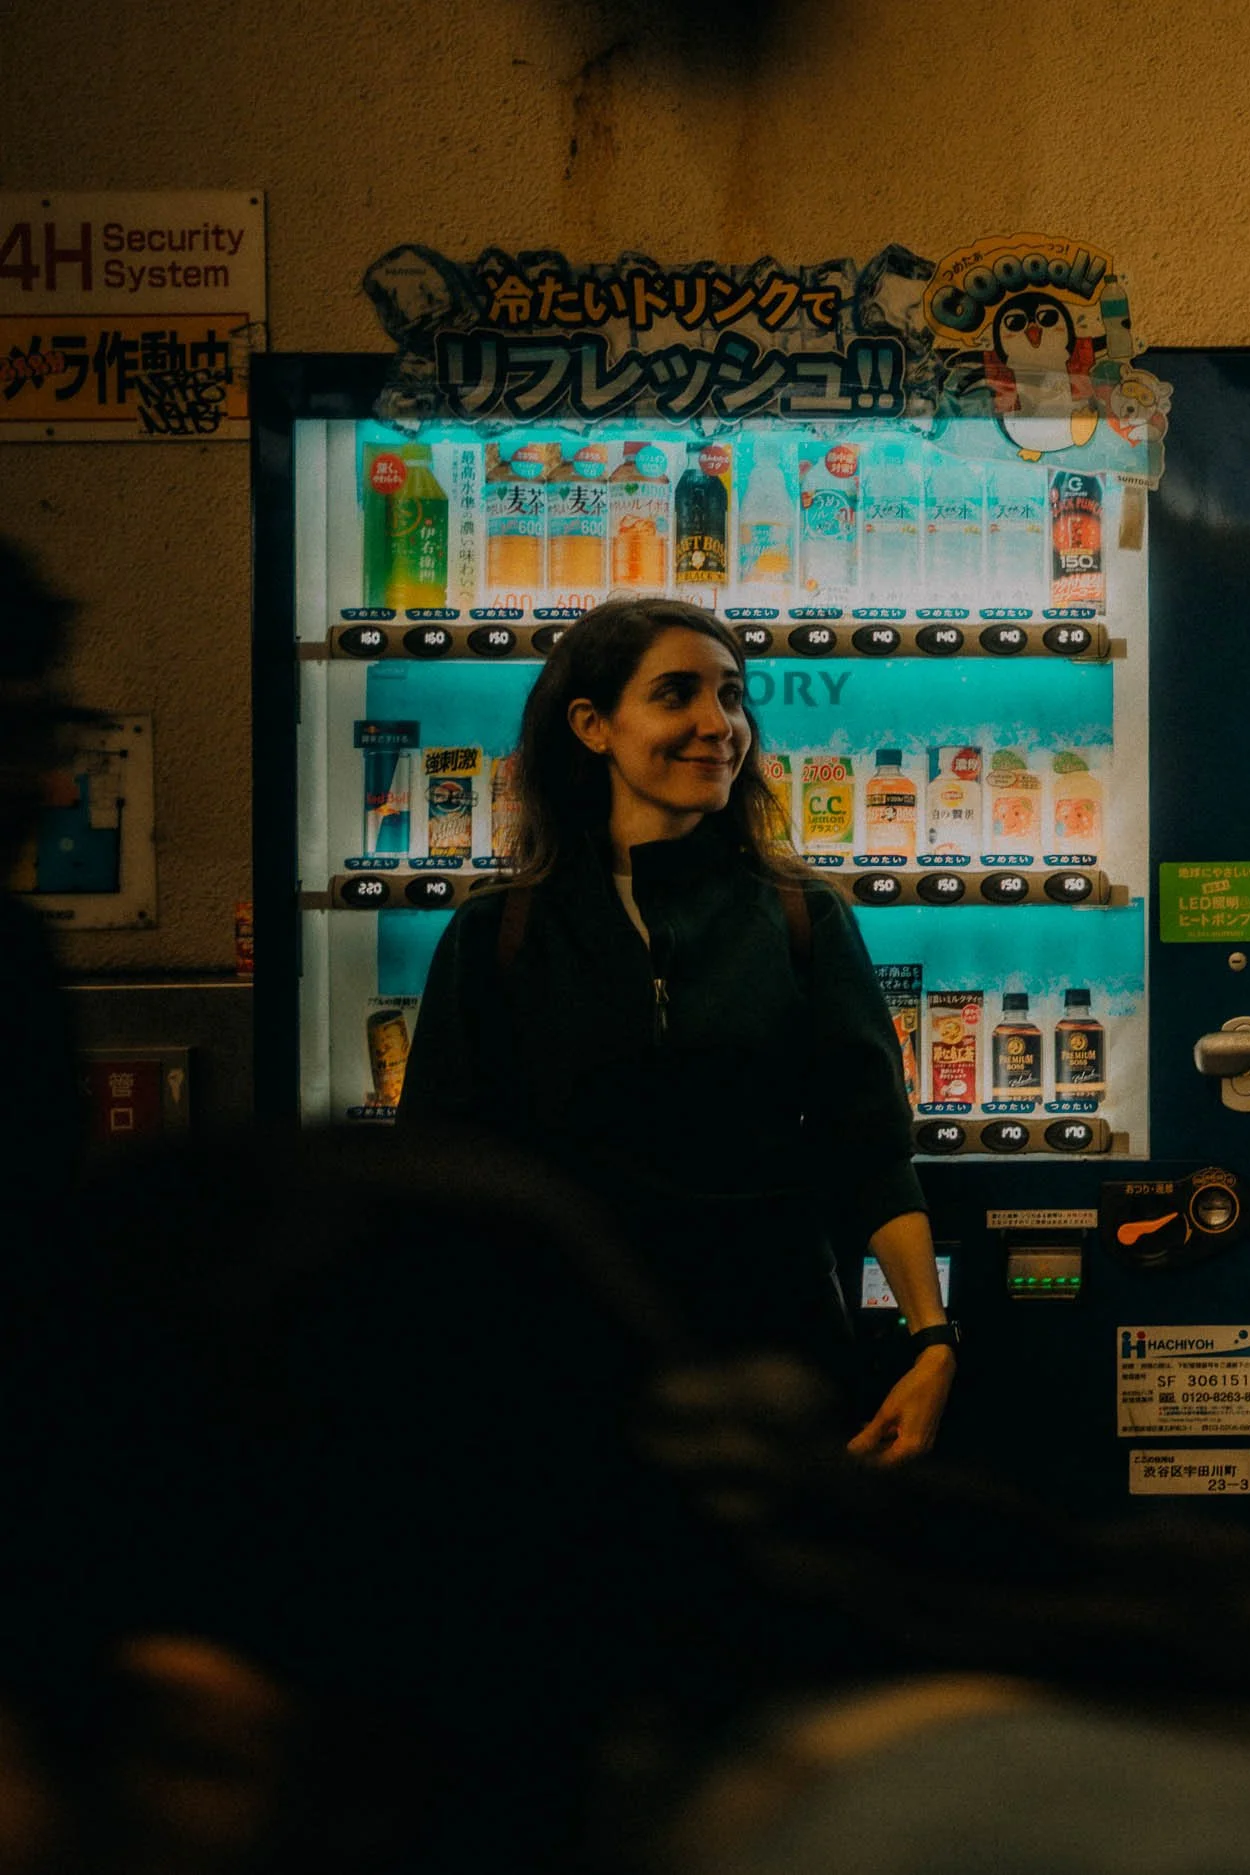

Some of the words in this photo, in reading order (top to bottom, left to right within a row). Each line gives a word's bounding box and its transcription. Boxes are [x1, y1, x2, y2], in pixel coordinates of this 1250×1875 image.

[103, 222, 244, 256] Security
[104, 259, 229, 293] System
[487, 274, 838, 328] 冷たいドリンクで
[444, 336, 896, 415] リフレッシュ!!
[1117, 474, 1154, 487] SUNTO
[507, 485, 545, 516] 麦茶
[568, 485, 608, 516] 麦茶
[518, 520, 542, 535] 600
[580, 520, 604, 535] 600
[1060, 555, 1095, 569] 150
[348, 609, 391, 618] つめたい
[412, 609, 455, 618] つめたい
[476, 609, 519, 618] つめたい
[731, 609, 774, 617] つめたい
[795, 609, 838, 617] つめたい
[858, 609, 901, 617] つめたい
[921, 608, 964, 618] つめたい
[984, 608, 1027, 618] つめたい
[1048, 608, 1092, 617] つめたい
[489, 631, 509, 645] 150
[745, 630, 765, 643] 140
[809, 630, 830, 643] 150
[873, 630, 893, 643] 140
[936, 630, 957, 643] 140
[1000, 629, 1020, 643] 140
[1058, 629, 1083, 643] 210
[424, 749, 478, 776] 強刺激
[803, 764, 845, 782] 2700
[351, 859, 394, 867] つめたい
[414, 858, 458, 867] つめたい
[806, 856, 839, 864] めたい
[859, 856, 902, 864] つめたい
[922, 855, 966, 864] つめたい
[986, 855, 1029, 864] つめたい
[1050, 855, 1092, 863] つめたい
[358, 882, 383, 895] 220
[426, 882, 446, 895] 140
[873, 879, 894, 892] 150
[938, 878, 958, 891] 150
[1001, 878, 1021, 891] 150
[1064, 877, 1085, 890] 150
[923, 1103, 967, 1112] つめたい
[987, 1103, 1030, 1112] つめたい
[1050, 1102, 1093, 1111] つめたい
[937, 1128, 958, 1140] 140
[1001, 1127, 1022, 1139] 170
[1065, 1126, 1085, 1138] 170
[1148, 1339, 1214, 1350] HACHIYOH
[1158, 1375, 1176, 1387] SF
[1188, 1374, 1248, 1386] 306151
[1143, 1465, 1237, 1478] 渋谷区宇田川町
